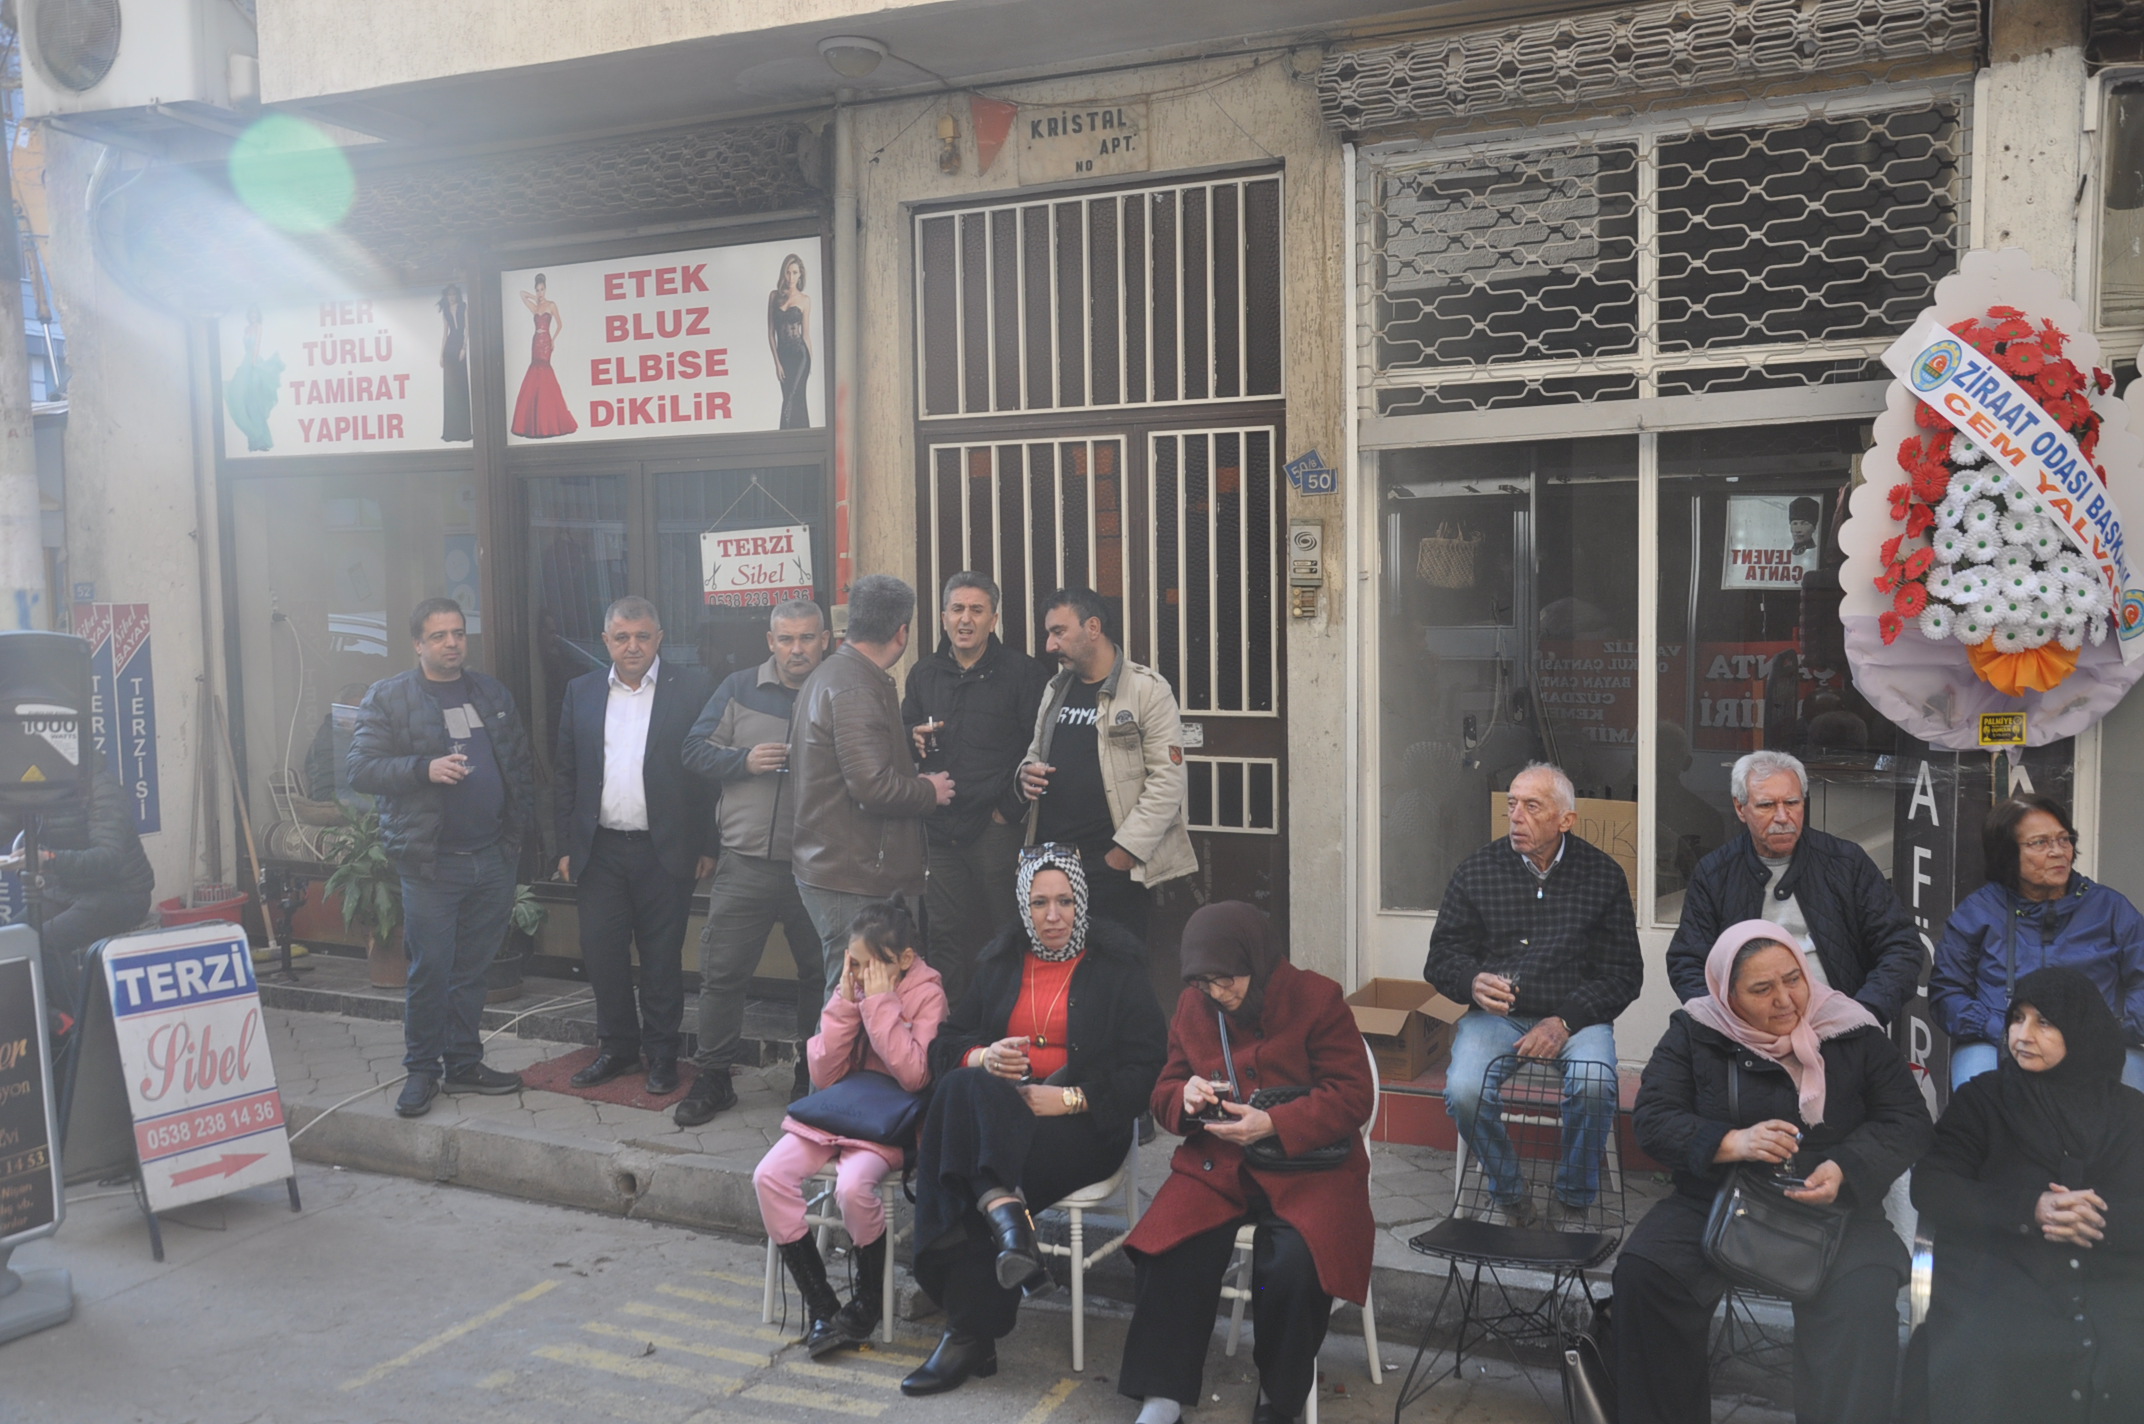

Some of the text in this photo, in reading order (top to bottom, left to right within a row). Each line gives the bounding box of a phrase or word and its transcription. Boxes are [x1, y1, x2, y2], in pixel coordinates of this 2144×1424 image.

[1031, 108, 1126, 139] KRİSTAL
[1076, 160, 1093, 173] NO
[604, 263, 710, 301] ETEK
[319, 299, 374, 327] HER
[605, 306, 711, 343] BLUZ
[302, 329, 393, 366] TÜRLÜ
[289, 370, 410, 405] TAMİRAT
[297, 413, 404, 443] YAPILIR
[1950, 360, 2039, 436] ZİRAAT
[2031, 430, 2094, 502] ODASI
[1308, 474, 1331, 489] 50
[1943, 392, 2121, 610] CEM YALVAÇ
[717, 528, 794, 558] TERZİ
[77, 585, 91, 597] 52
[731, 562, 785, 586] Sibel
[709, 593, 741, 607] 0538
[745, 591, 769, 607] 238
[115, 614, 149, 668] BAYAN
[24, 720, 77, 734] 1000
[130, 677, 149, 821] TERZİSİ
[115, 944, 248, 1007] TERZİ
[140, 1007, 258, 1102] Sibel
[147, 1099, 275, 1150] 0538 238 14 36
